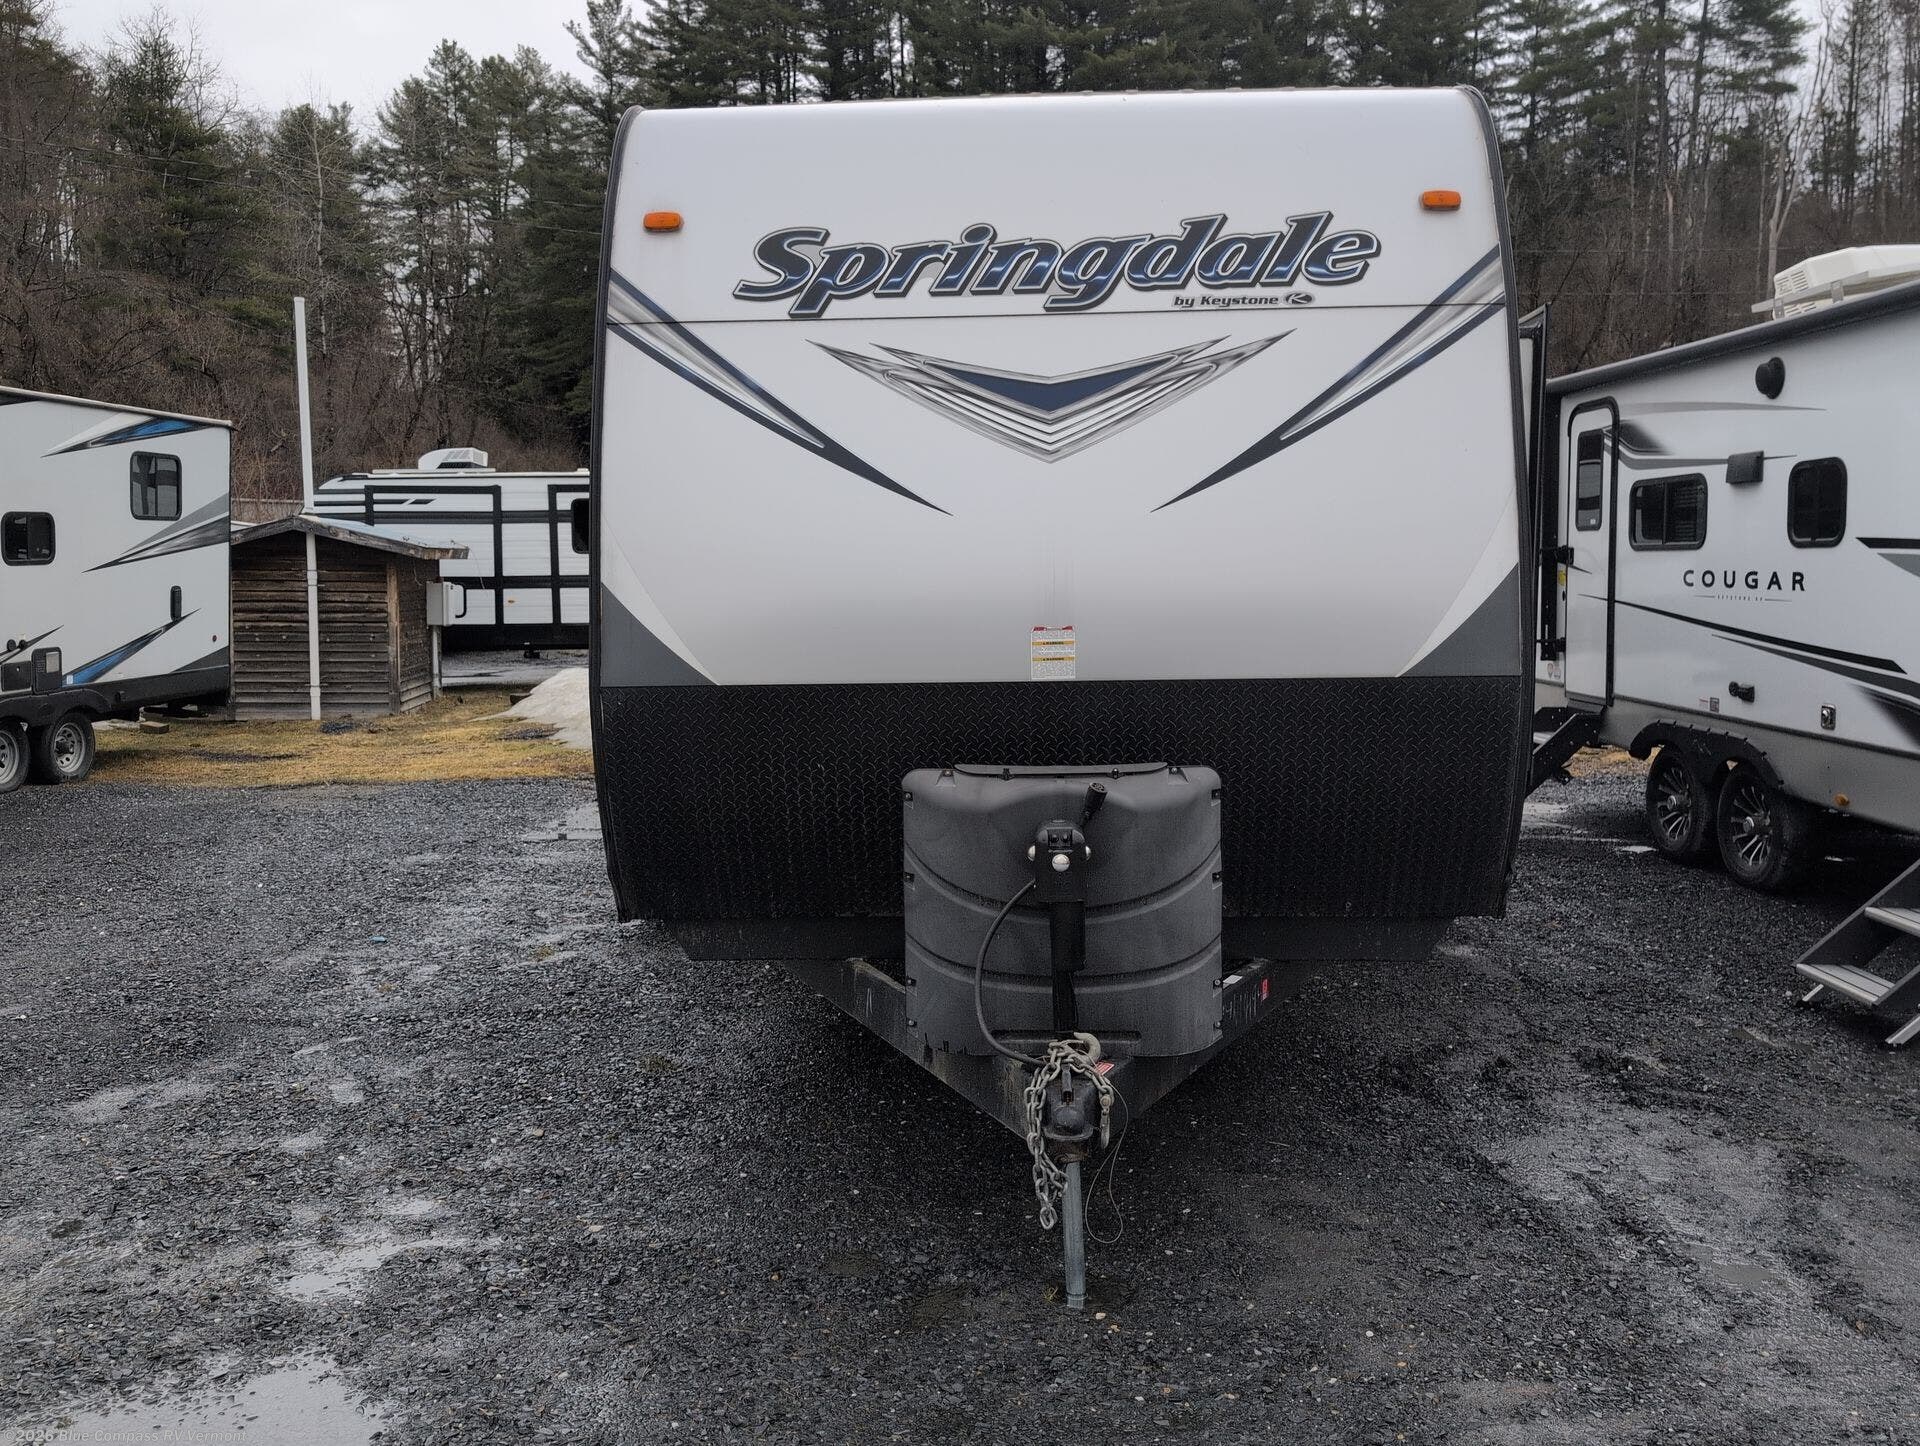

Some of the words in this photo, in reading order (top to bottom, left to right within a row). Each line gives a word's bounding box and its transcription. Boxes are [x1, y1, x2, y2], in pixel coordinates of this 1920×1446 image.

[733, 210, 1381, 319] Springdale
[1173, 296, 1195, 308] by
[1200, 295, 1279, 308] Keystone
[1683, 569, 1805, 592] COUGAR
